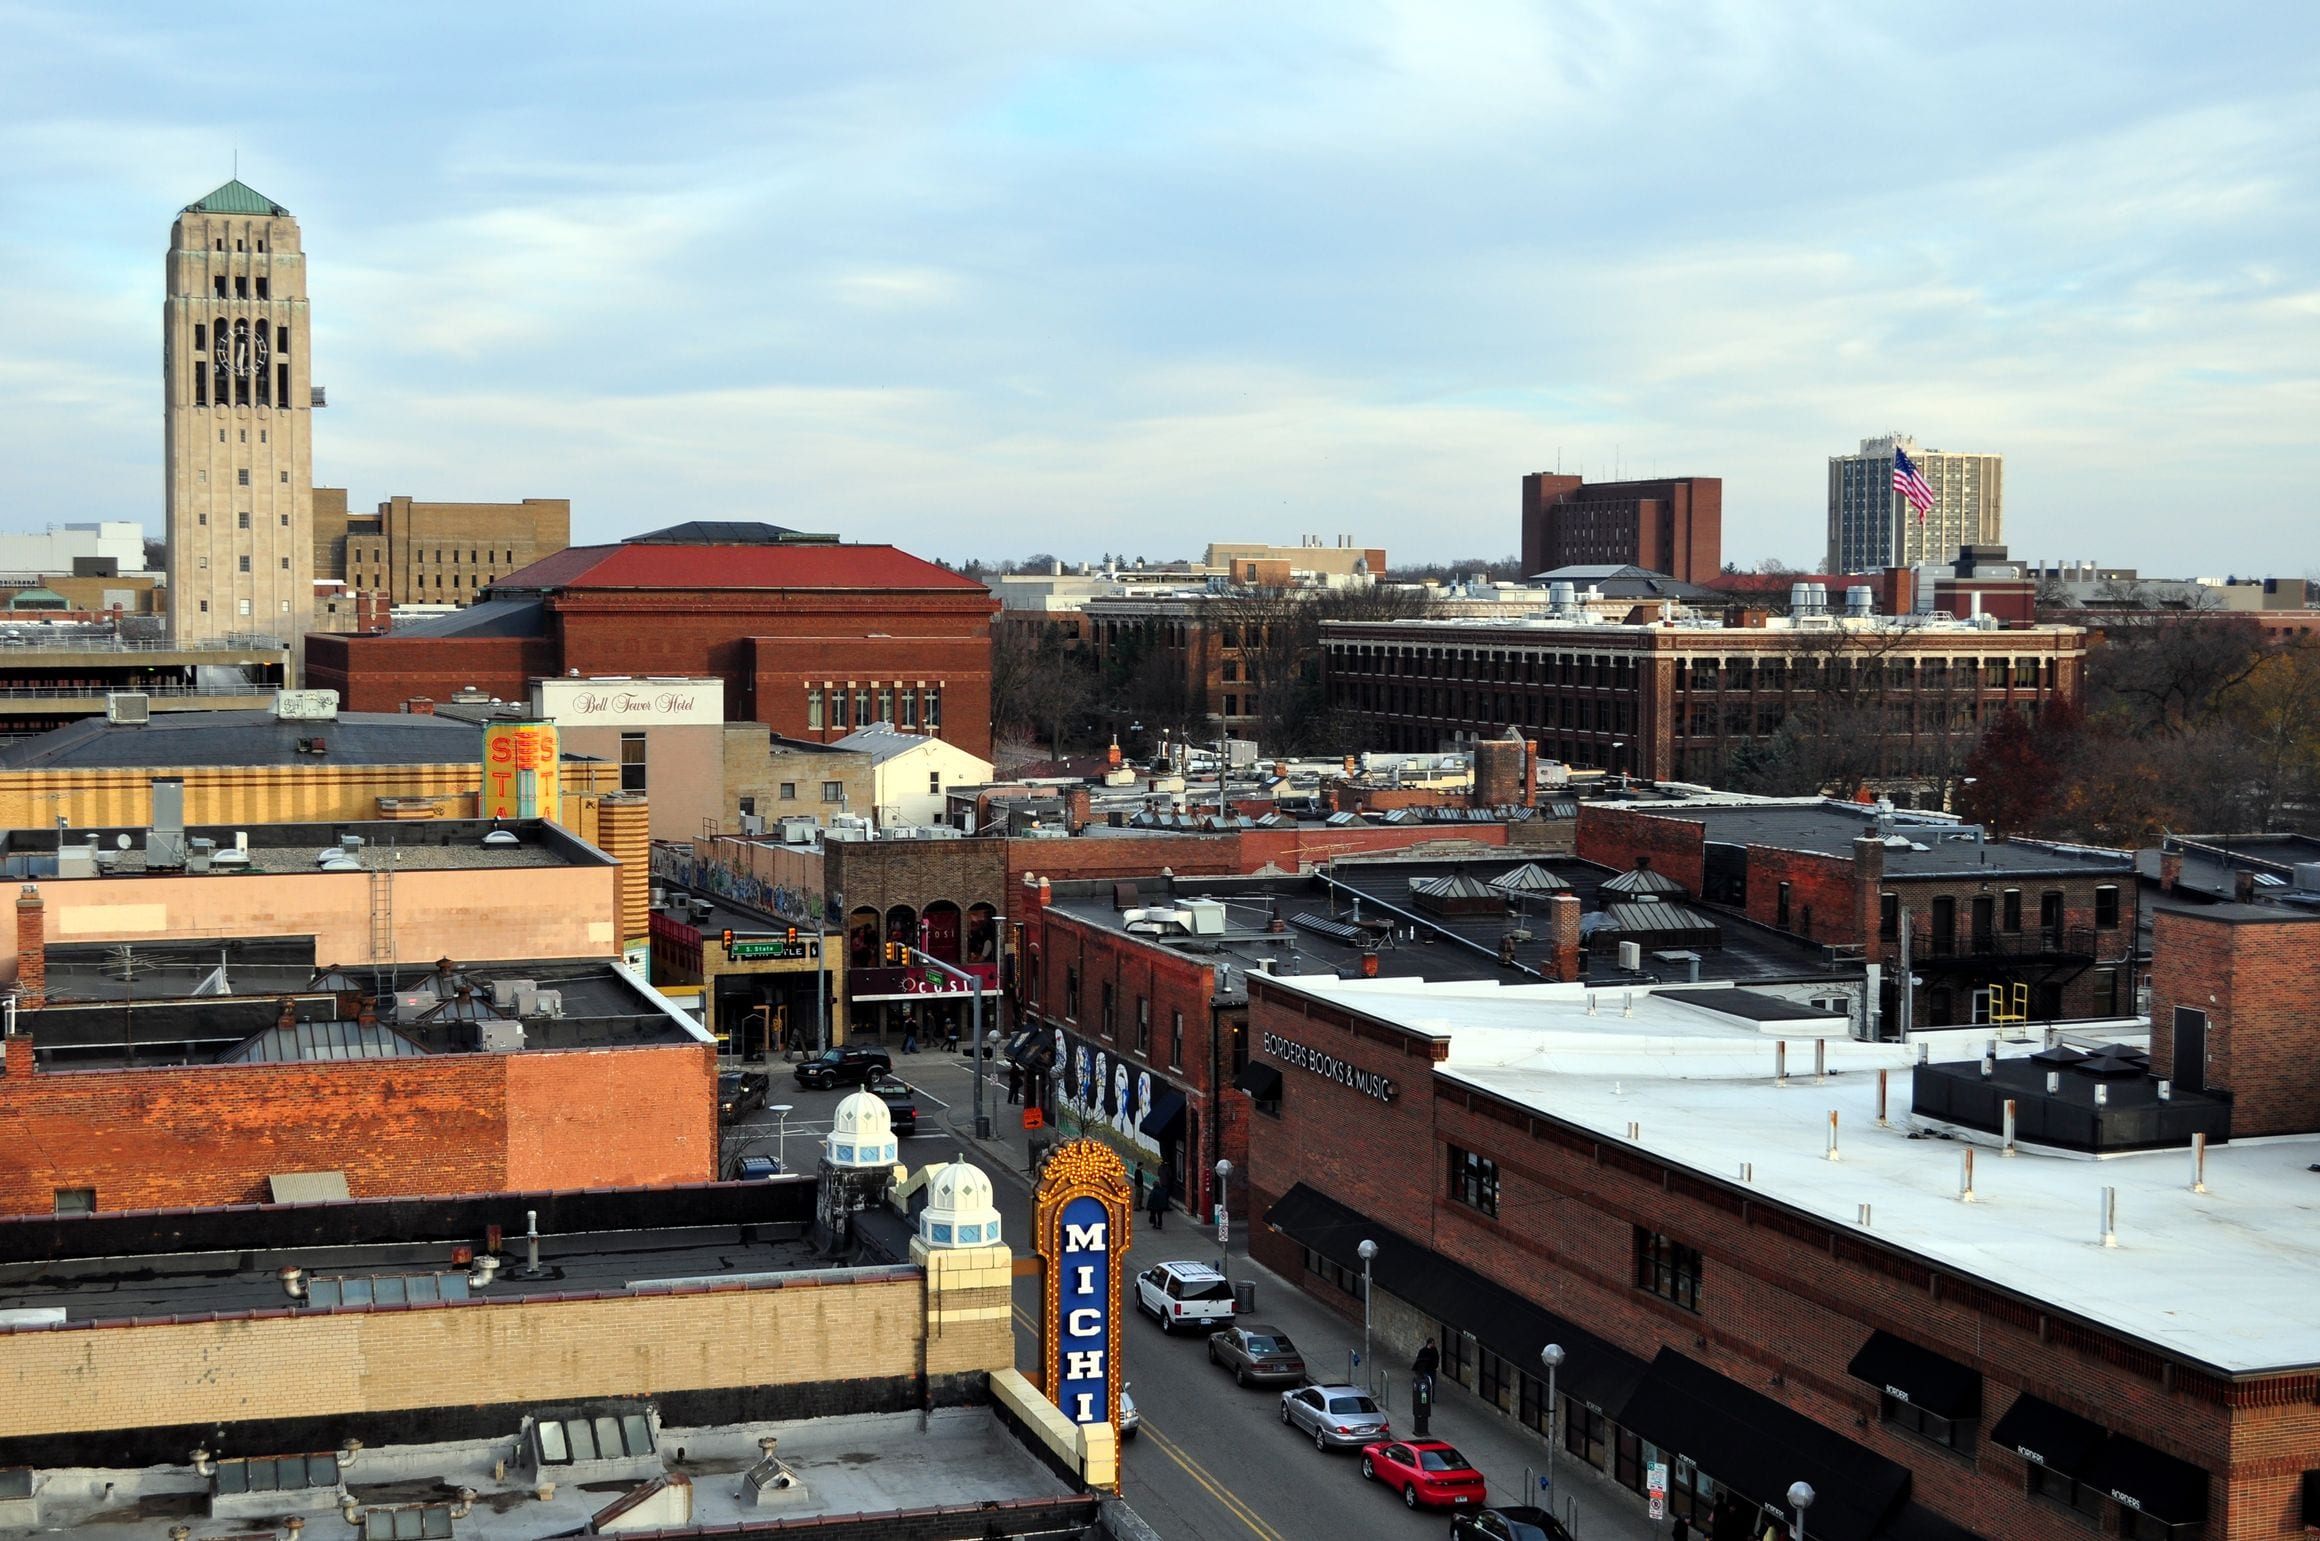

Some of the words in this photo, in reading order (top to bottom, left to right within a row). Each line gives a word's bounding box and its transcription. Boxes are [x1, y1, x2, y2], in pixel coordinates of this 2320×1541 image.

[573, 692, 608, 714] Bell
[612, 692, 651, 713] Tower
[655, 692, 694, 713] Hotel
[919, 980, 968, 993] COSI
[1264, 1032, 1306, 1067] BORDERS
[1309, 1050, 1343, 1083] BOOKS
[1346, 1065, 1353, 1086] &
[1356, 1069, 1388, 1101] MUSIC
[1066, 1223, 1106, 1422] MICHI
[1886, 1384, 1908, 1402] BORDERS
[2018, 1445, 2044, 1464] BORDERS
[2111, 1489, 2140, 1510] BORDERS
